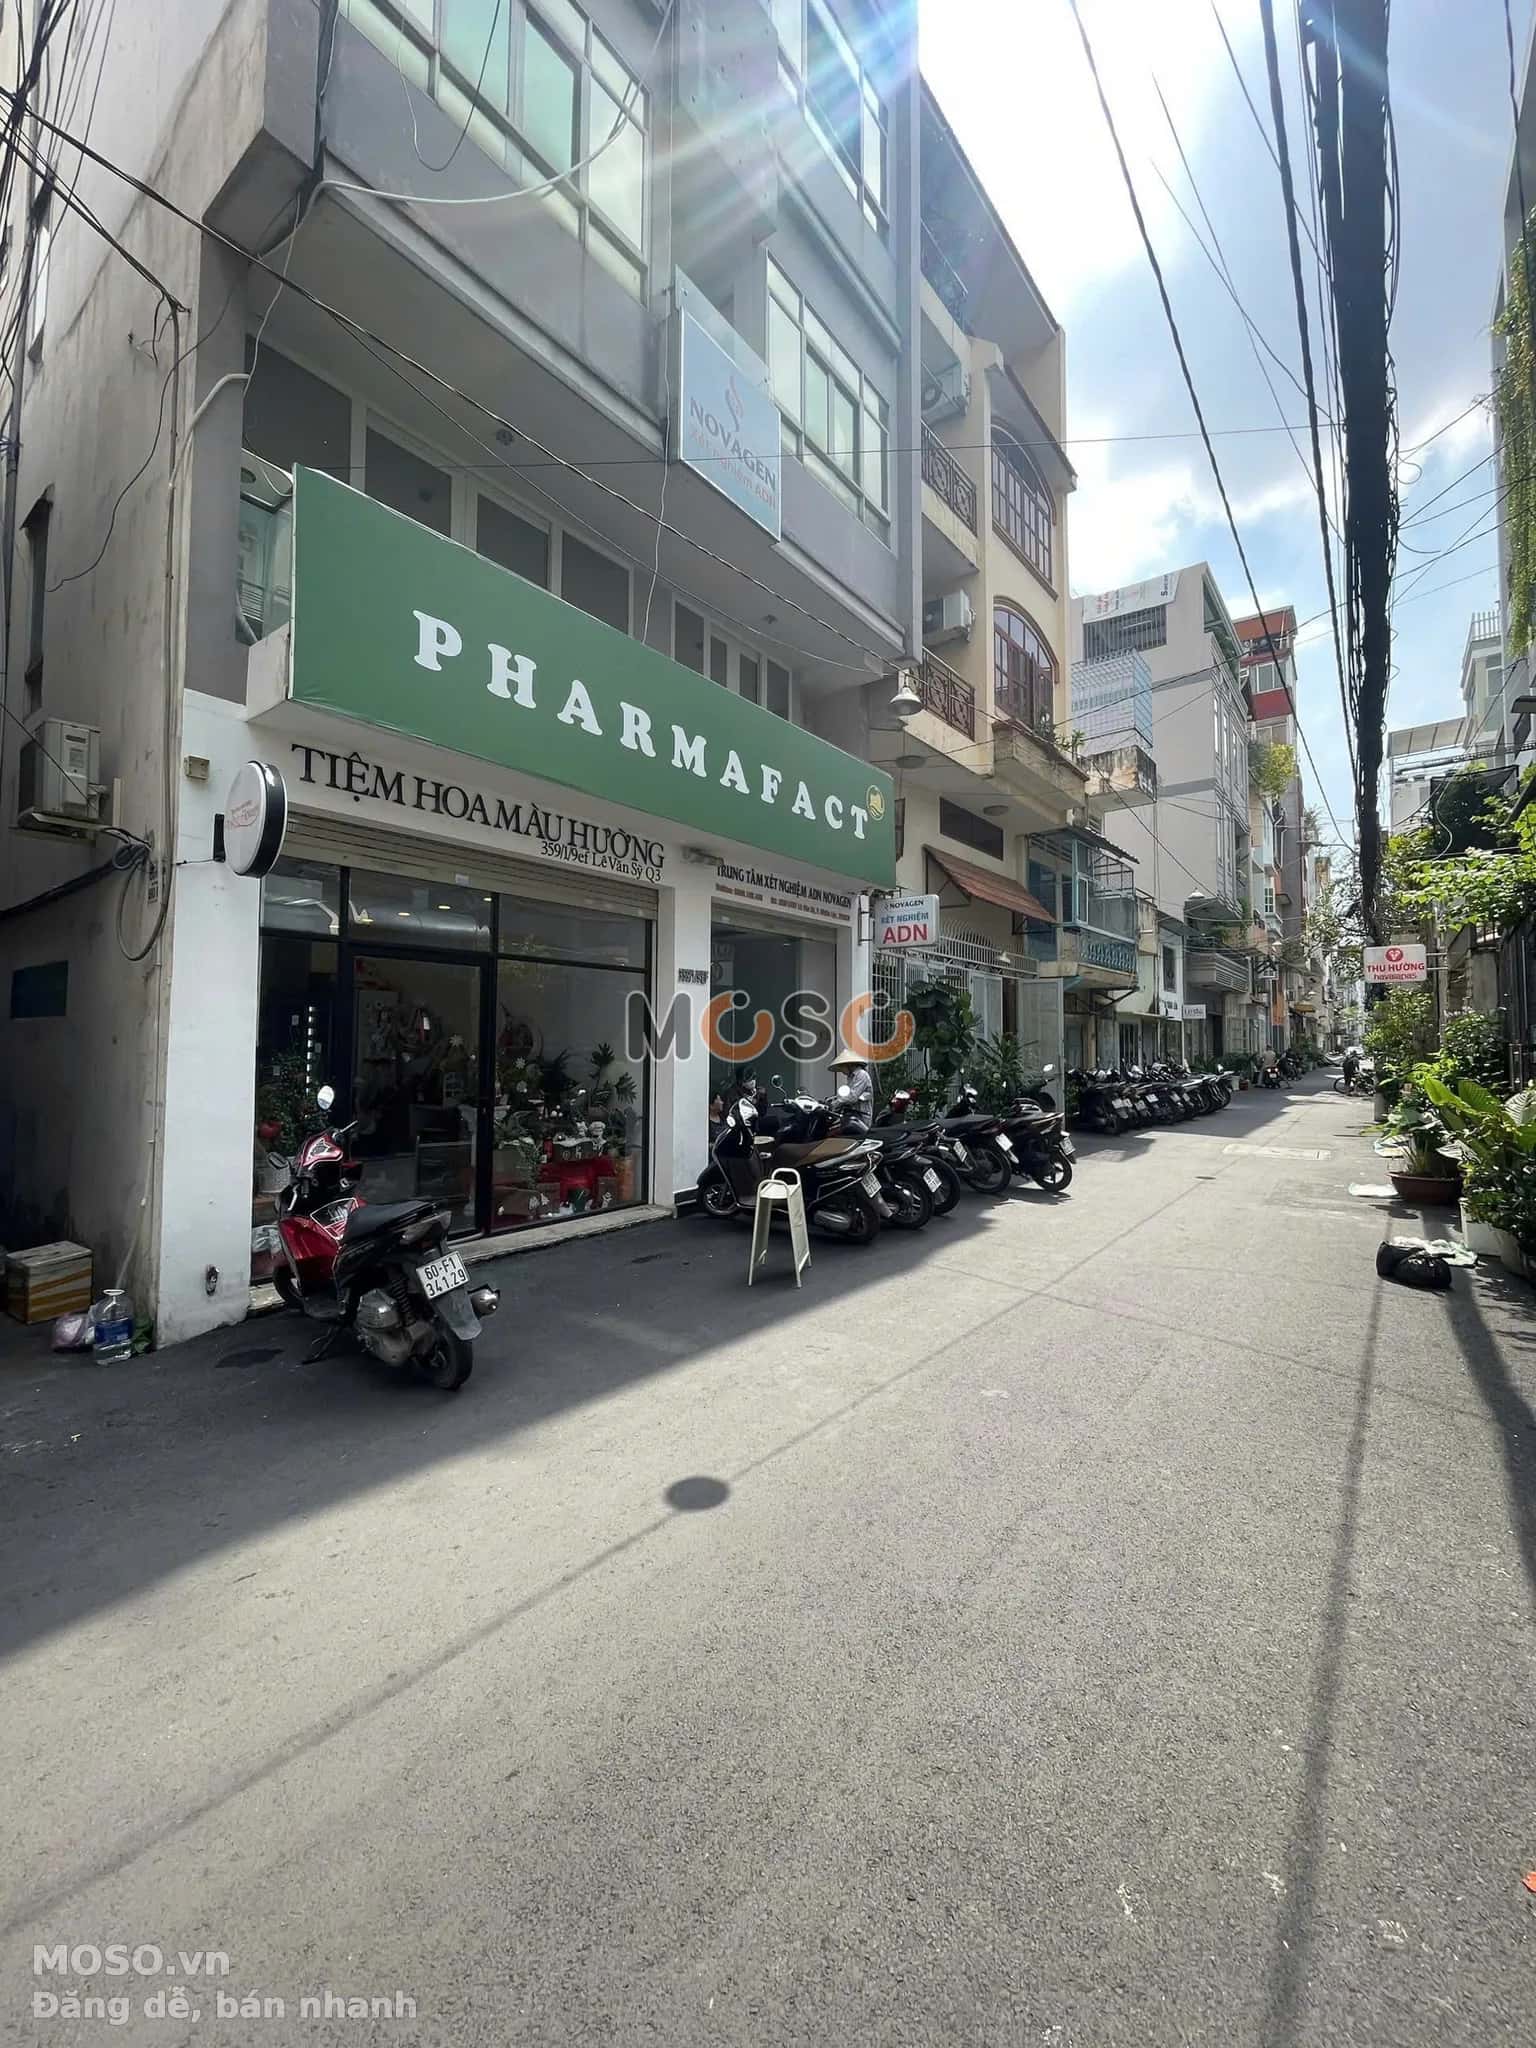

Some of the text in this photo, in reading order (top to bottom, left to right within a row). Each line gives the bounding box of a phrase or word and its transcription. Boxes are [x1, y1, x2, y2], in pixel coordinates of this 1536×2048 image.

[690, 397, 776, 493] NOVAGEN
[412, 609, 868, 840] PHARMAFACT
[291, 743, 665, 869] TIỆM HOA MÀU HƯỜNG
[592, 852, 607, 868] Lê
[645, 866, 661, 884] Q3
[717, 863, 745, 882] TRUNG
[745, 868, 763, 887] TÂM
[764, 873, 778, 889] XÉT
[778, 880, 807, 898] NGHIỆM
[808, 887, 821, 902] ADN
[822, 890, 852, 909] NOVAGEN
[889, 899, 924, 909] NOVAGEN
[883, 923, 928, 944] ADN
[1367, 964, 1386, 973] THU
[424, 1257, 456, 1280] 60-F1
[425, 1268, 467, 1297] 341.29
